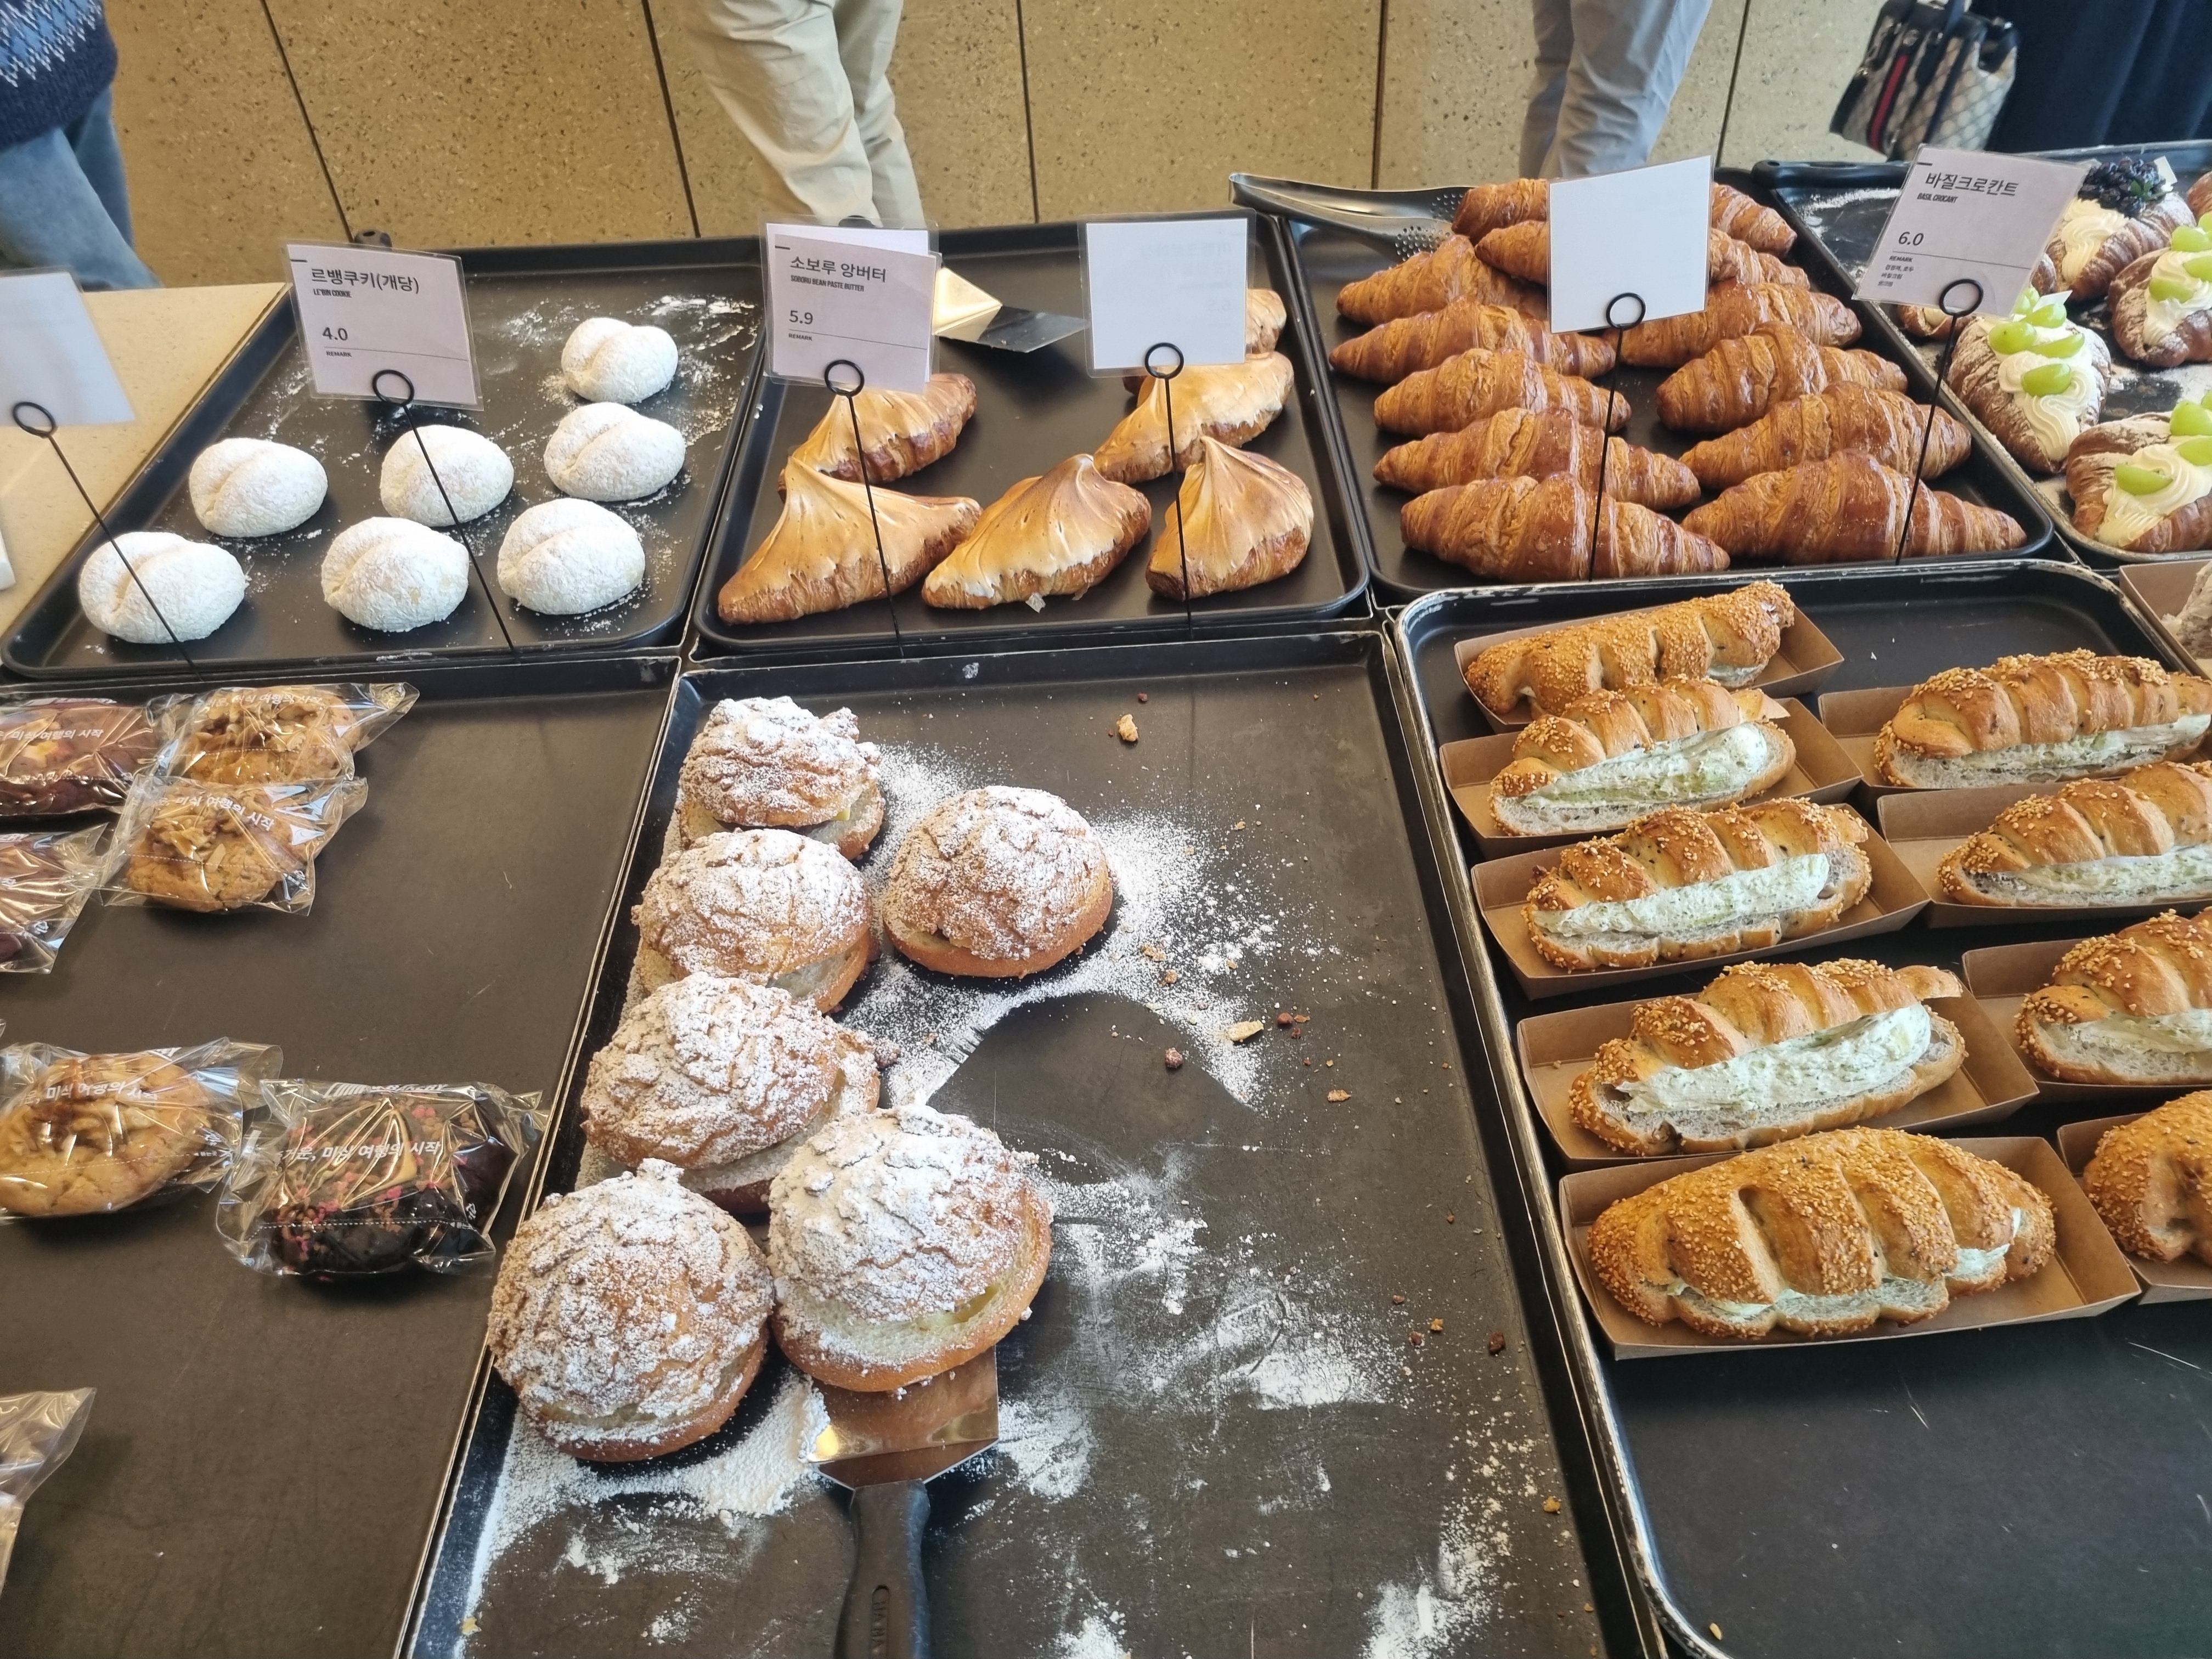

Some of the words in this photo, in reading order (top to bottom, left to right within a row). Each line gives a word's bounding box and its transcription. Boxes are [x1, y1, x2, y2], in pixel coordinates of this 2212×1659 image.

[1925, 172, 2019, 196] 바질크로칸트
[1917, 193, 1932, 201] BASIL
[1899, 232, 1924, 246] 6.0
[790, 256, 837, 275] 소보루
[840, 263, 887, 283] 앙버터
[312, 268, 419, 294] 르뱅쿠키(개당)
[791, 275, 811, 284] SOBORU
[812, 278, 827, 287] BEAN
[827, 280, 844, 289] PASTE
[844, 283, 865, 292] BUTTER
[789, 310, 814, 325] 5.9
[323, 327, 348, 341] 4.0
[788, 332, 812, 341] REMARK
[40, 729, 77, 740] 여행의
[78, 728, 104, 738] 시작
[206, 795, 245, 816] 여행의
[247, 811, 274, 831] 시작
[46, 1082, 74, 1101] 미식
[358, 1144, 404, 1159] 여행의
[410, 1141, 442, 1155] 시작
